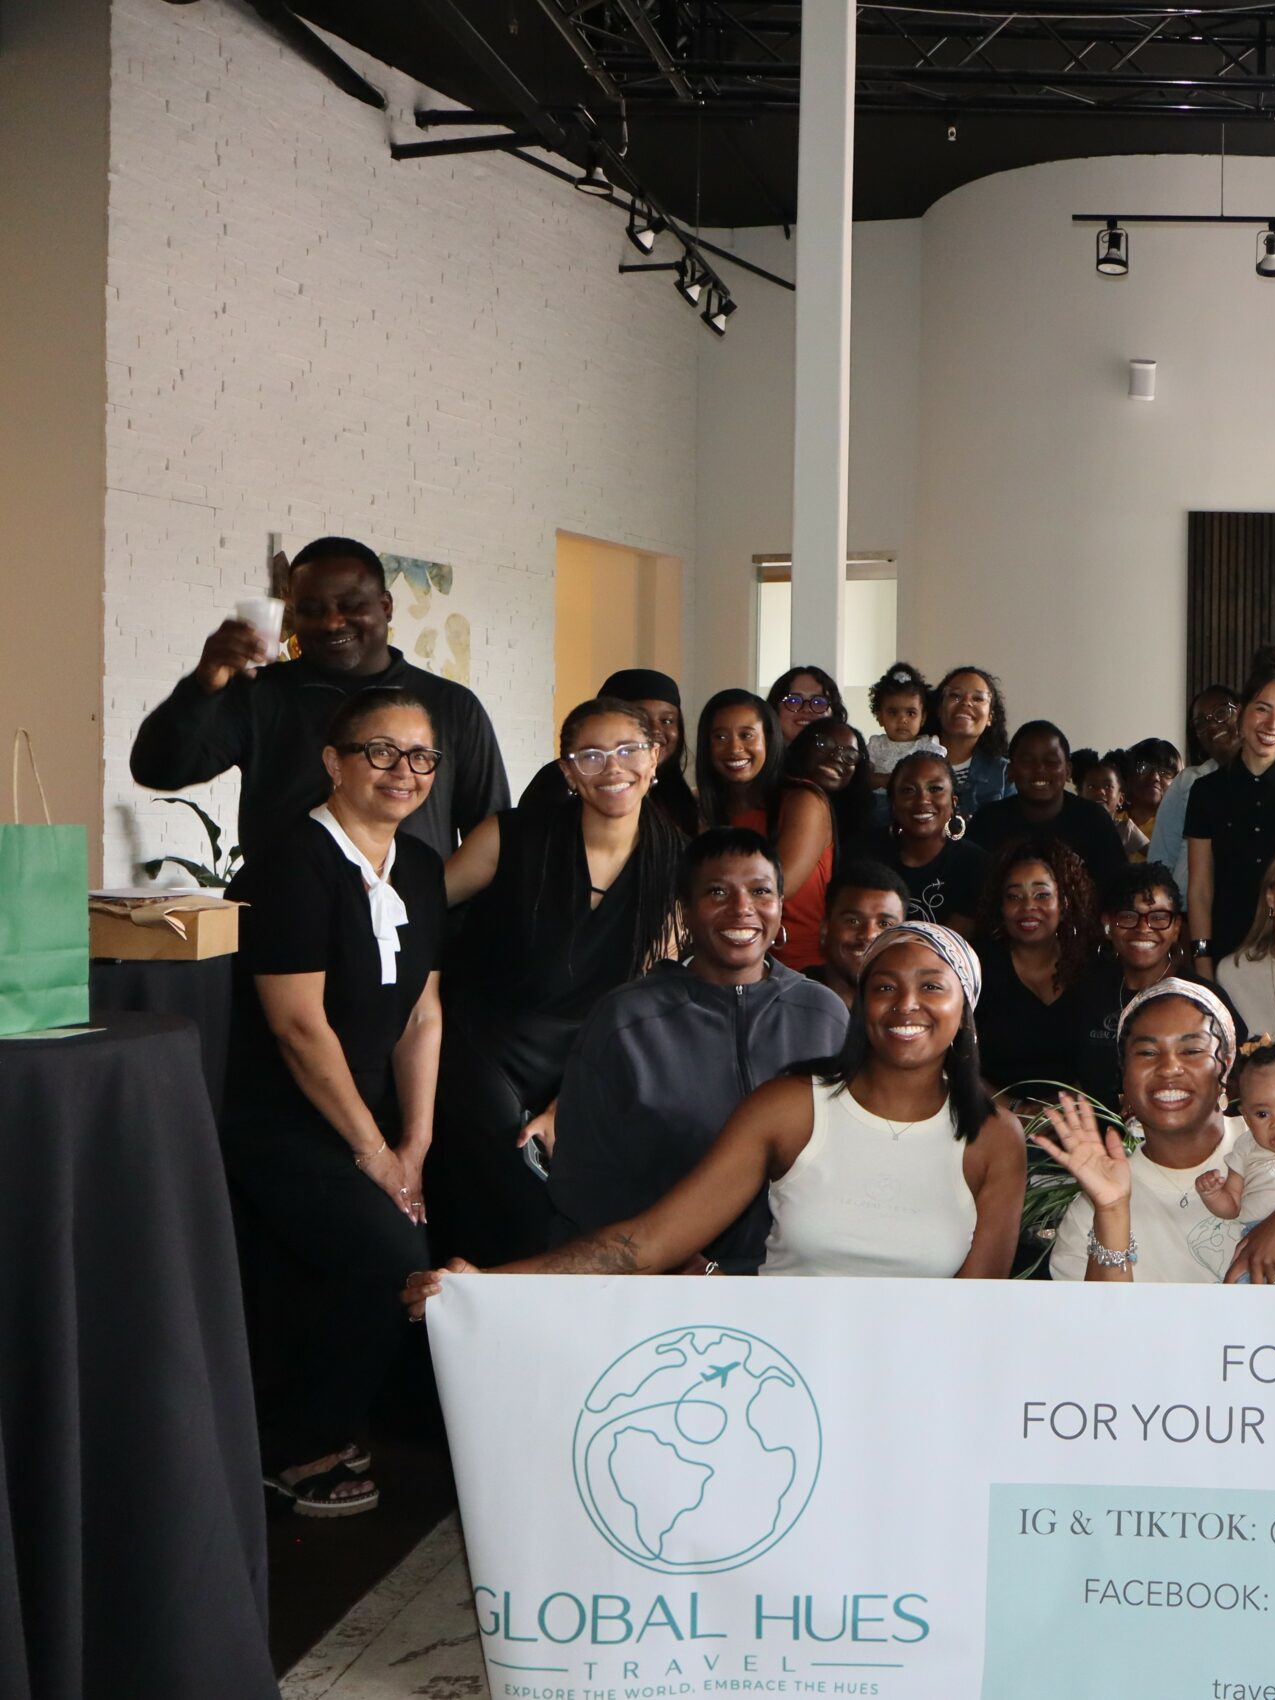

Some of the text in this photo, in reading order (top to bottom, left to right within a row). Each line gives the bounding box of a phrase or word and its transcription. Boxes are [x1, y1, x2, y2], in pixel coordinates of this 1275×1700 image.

[1023, 1402, 1118, 1441] FOR
[1132, 1403, 1265, 1445] YOUR
[1018, 1508, 1058, 1536] IG
[1070, 1510, 1094, 1536] &
[1106, 1510, 1257, 1542] TIKTOK:
[1084, 1577, 1269, 1613] FACEBOOK:
[474, 1586, 930, 1646] GLOBAL HUES
[583, 1653, 797, 1681] TRAVEL
[503, 1683, 576, 1700] EXPLORE
[582, 1689, 617, 1700] THE
[703, 1678, 787, 1692] EMBRACE
[793, 1679, 827, 1694] THE
[833, 1681, 879, 1696] HUES
